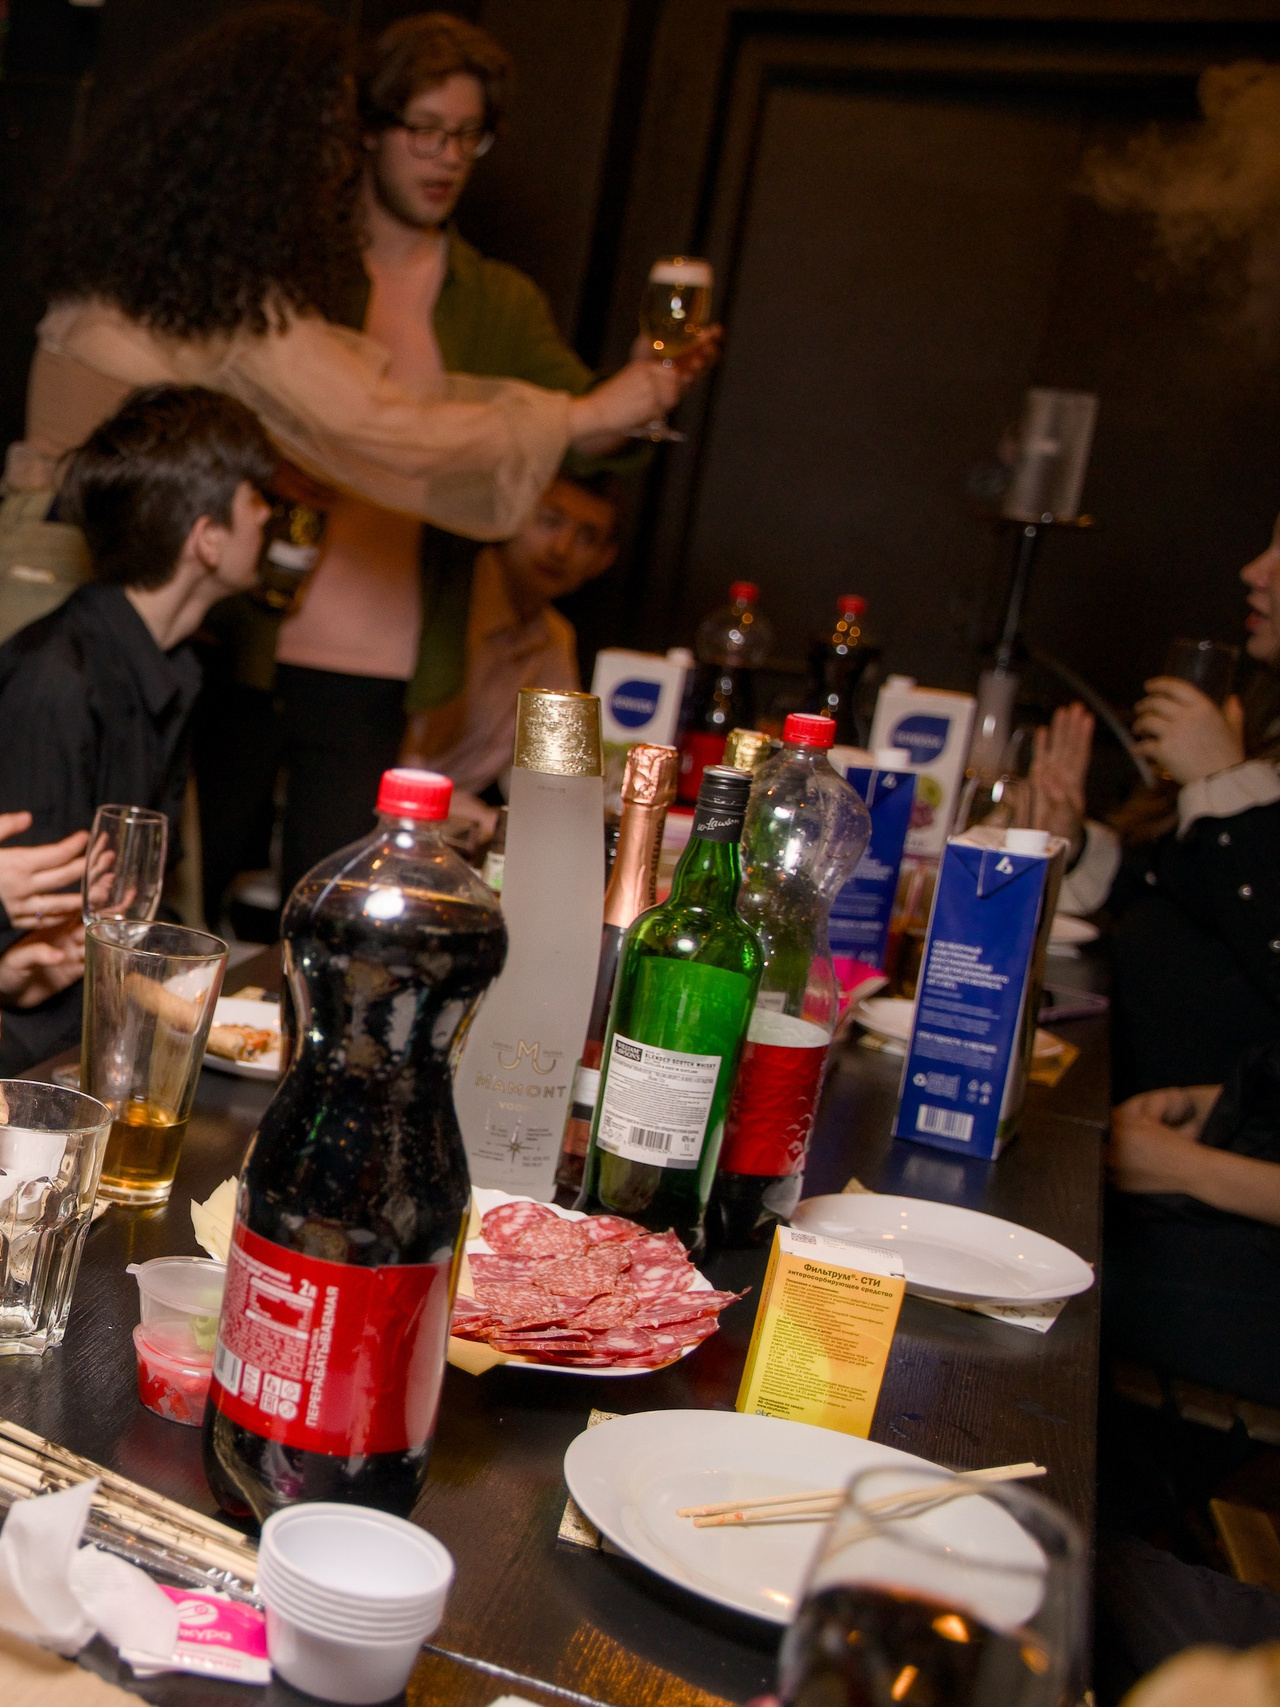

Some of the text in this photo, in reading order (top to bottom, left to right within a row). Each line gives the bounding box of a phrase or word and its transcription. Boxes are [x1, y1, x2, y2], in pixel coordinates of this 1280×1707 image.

[860, 1276, 881, 1288] СТИ
[861, 1287, 893, 1298] средство
[305, 1285, 340, 1429] ПЕРЕРАБАТЫВАЕМАЯ
